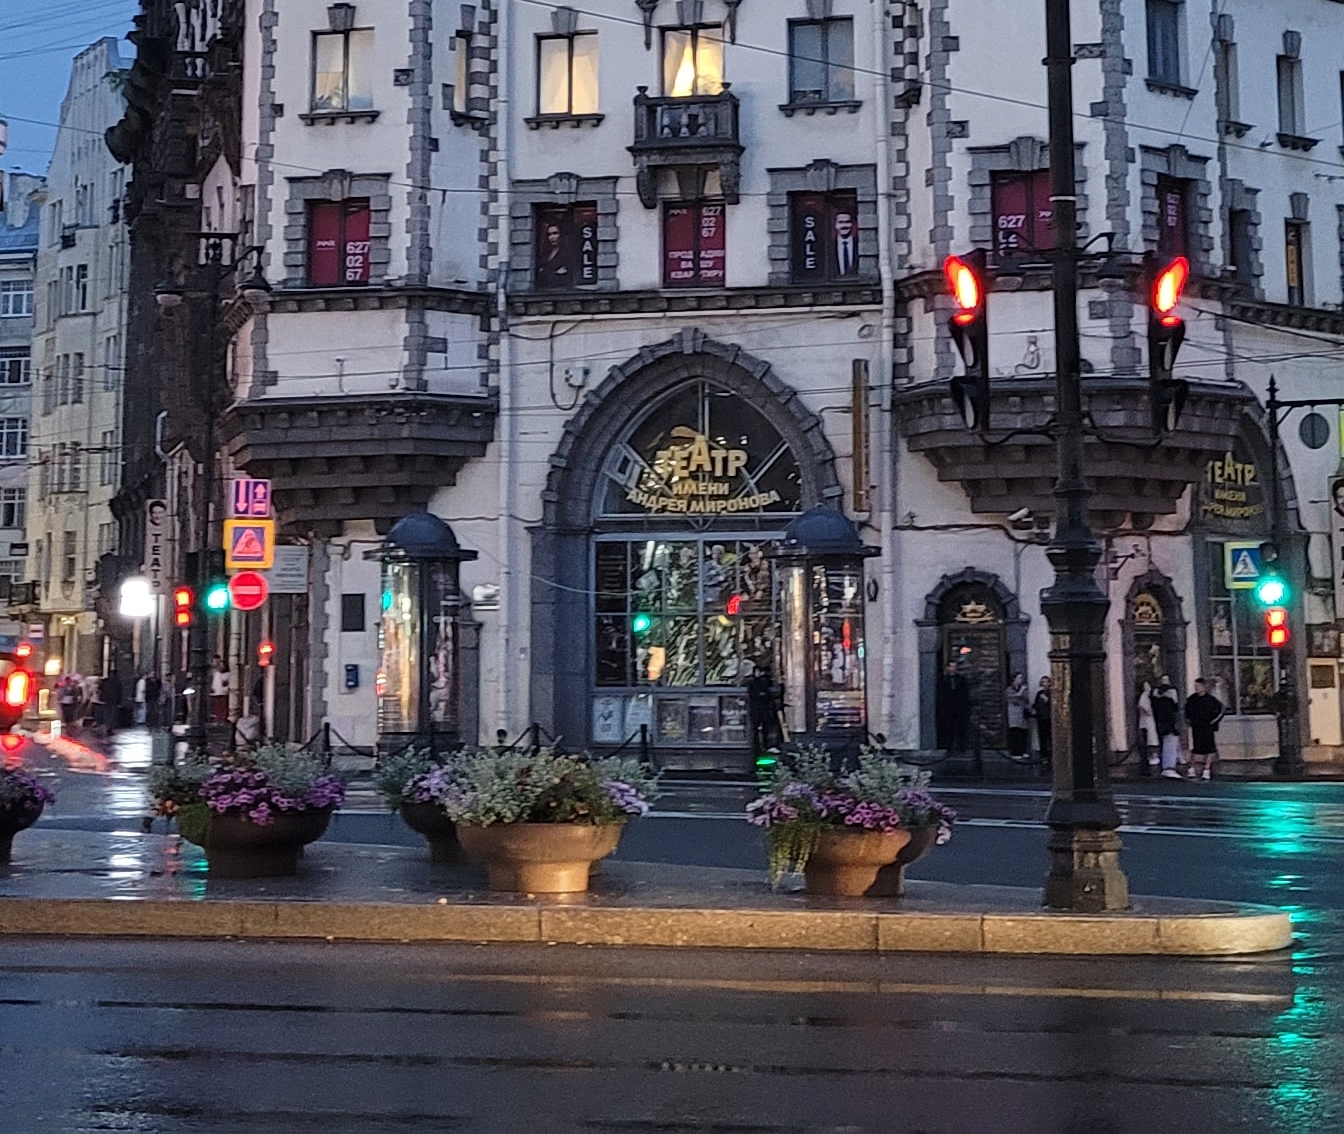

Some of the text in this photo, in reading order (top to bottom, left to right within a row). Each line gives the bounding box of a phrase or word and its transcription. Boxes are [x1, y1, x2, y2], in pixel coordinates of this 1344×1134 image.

[998, 215, 1026, 228] 627
[701, 228, 716, 238] 67
[346, 242, 371, 254] 627
[804, 216, 816, 269] SALE
[582, 226, 594, 279] SALE
[346, 255, 364, 267] 02
[346, 268, 364, 281] 67
[655, 435, 748, 478] ТЕАТР
[672, 482, 729, 495] ИМЕНИ
[626, 488, 781, 513] АНДРЕЯ МИРОНОВА
